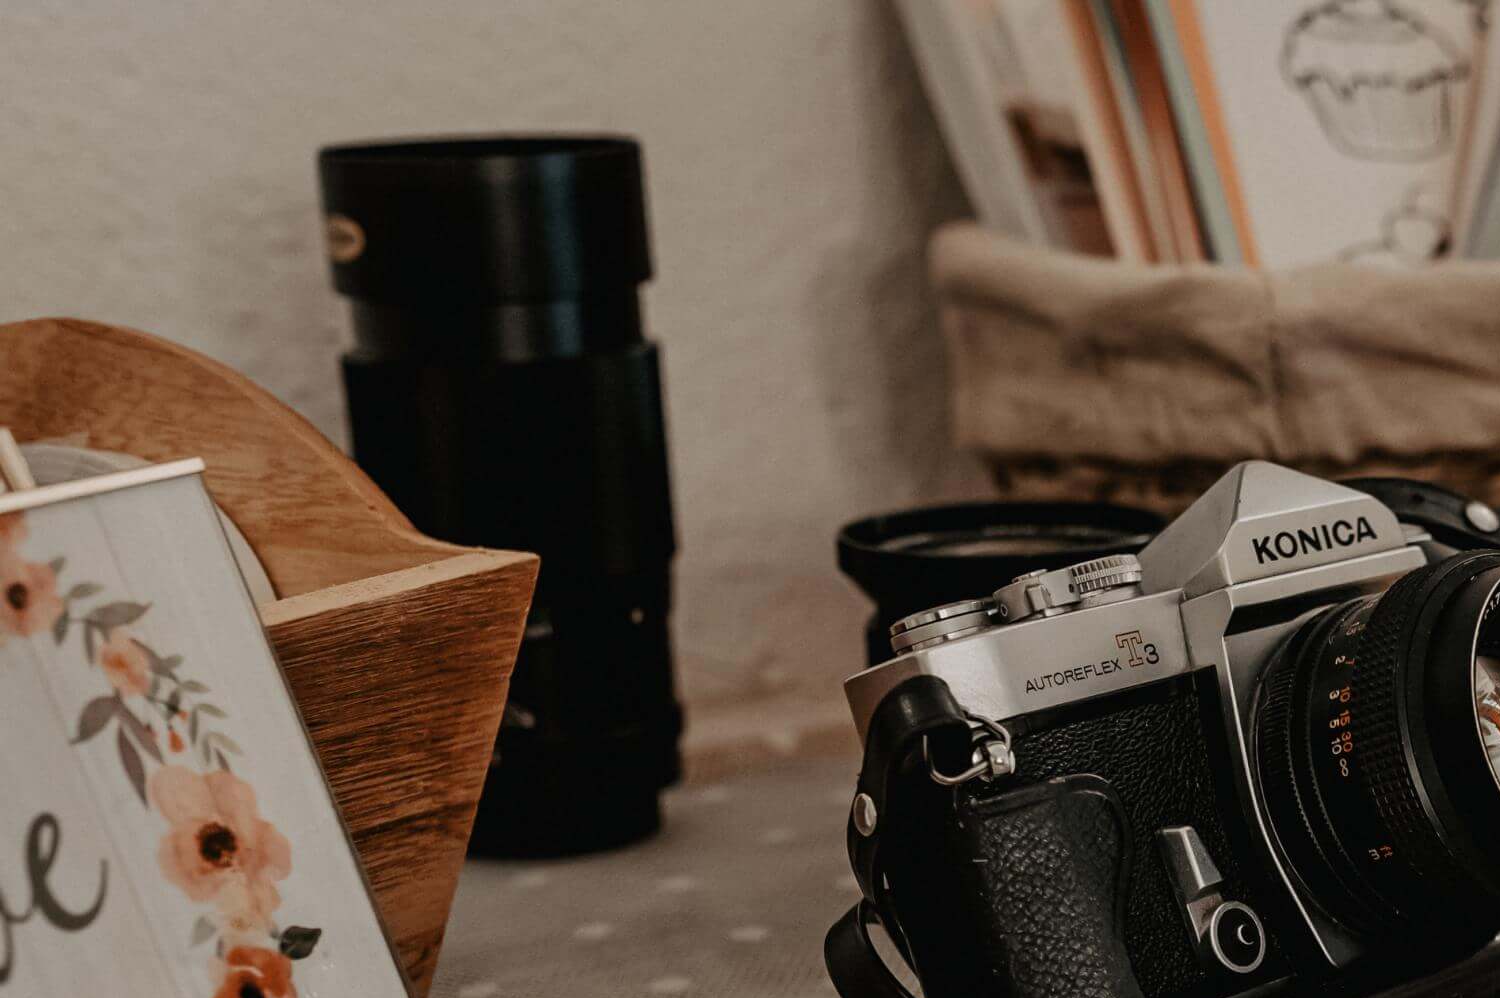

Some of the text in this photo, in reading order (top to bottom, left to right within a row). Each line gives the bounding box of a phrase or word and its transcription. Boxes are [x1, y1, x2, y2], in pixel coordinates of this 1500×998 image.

[1251, 515, 1378, 565] KONICA
[1025, 657, 1122, 694] AUTOREFLEX
[1329, 689, 1340, 700] 3
[1340, 685, 1351, 703] 10
[1329, 718, 1340, 729] 5
[1339, 709, 1351, 727] 15
[1331, 737, 1342, 755] 10
[1341, 731, 1353, 752] 30
